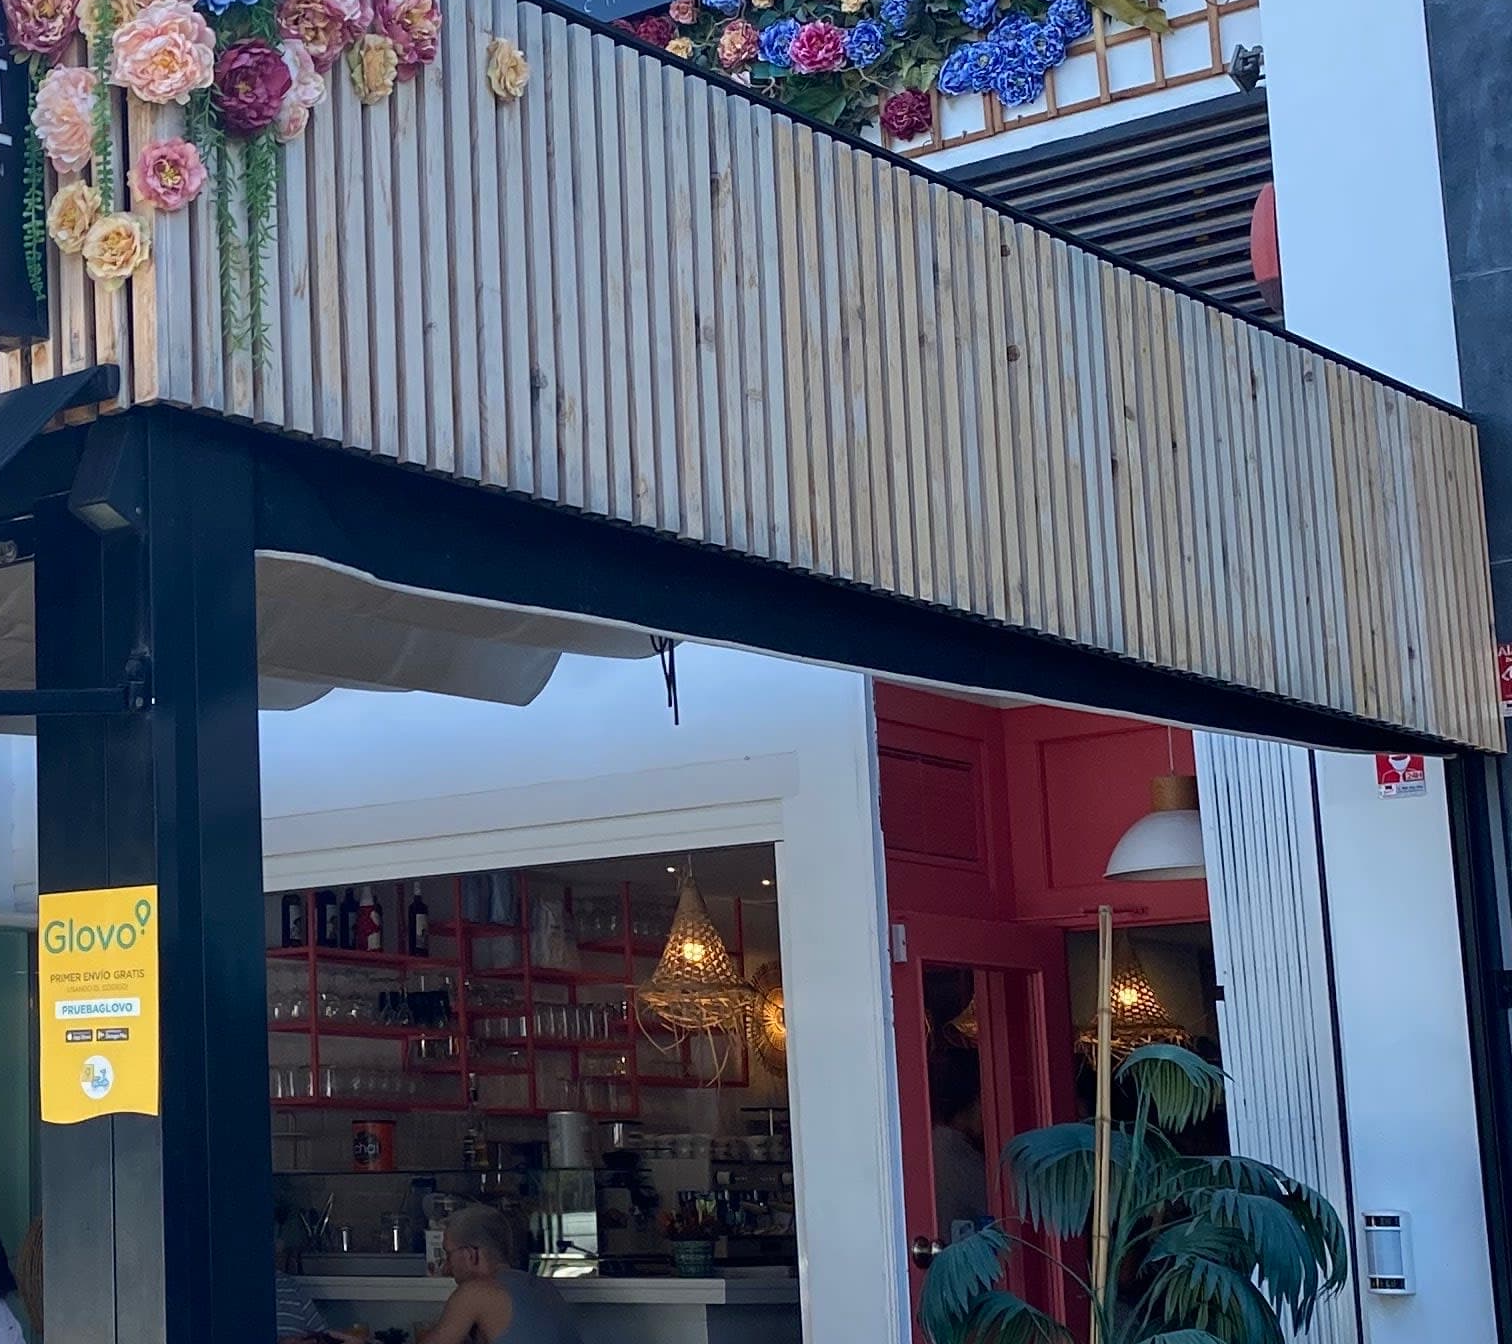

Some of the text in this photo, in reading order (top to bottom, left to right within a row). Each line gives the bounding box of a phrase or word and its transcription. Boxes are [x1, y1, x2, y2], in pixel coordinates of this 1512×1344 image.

[44, 917, 137, 954] Glovo
[50, 968, 145, 984] PRIMER ENVÍO GRATIS
[61, 1002, 133, 1015] PRUEBAGLOVO
